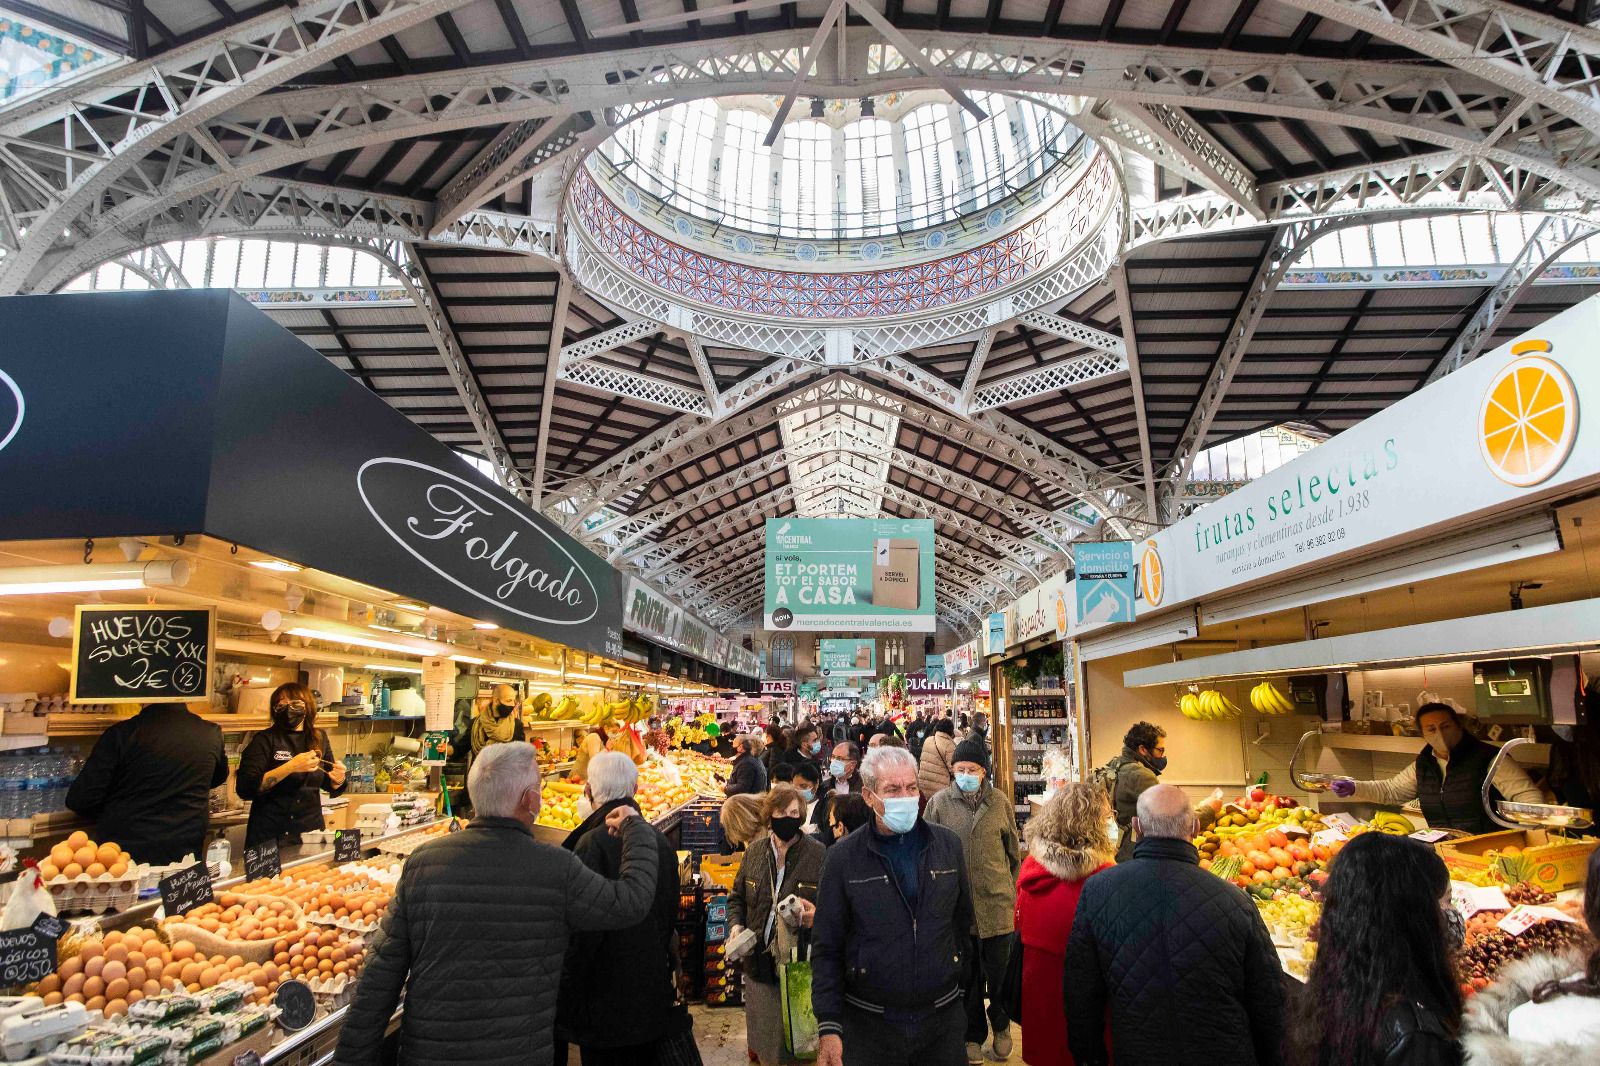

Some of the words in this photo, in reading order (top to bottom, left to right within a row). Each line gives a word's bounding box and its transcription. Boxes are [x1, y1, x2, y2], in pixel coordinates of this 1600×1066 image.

[1195, 506, 1255, 552] frutas
[1268, 438, 1399, 521] selectas
[1253, 521, 1303, 550] clementinas
[1306, 505, 1334, 530] desde
[1339, 490, 1370, 518] 1.938
[407, 484, 582, 606] Folgado
[784, 535, 812, 545] CENTRAL
[1078, 549, 1121, 561] Servicio
[775, 563, 793, 576] ET
[797, 563, 857, 576] PORTEM
[1080, 561, 1129, 573] domicilio
[775, 575, 797, 586] TOT
[801, 575, 814, 586] EL
[818, 575, 857, 586] SABOR
[775, 585, 789, 605] A
[798, 585, 857, 605] CASA
[774, 613, 791, 623] NOVA
[796, 617, 913, 628] mercadocentralvalencia.es
[90, 615, 192, 643] HUEVOS
[88, 638, 171, 663] SUPER
[175, 642, 207, 665] XXL
[114, 658, 169, 689] 2€
